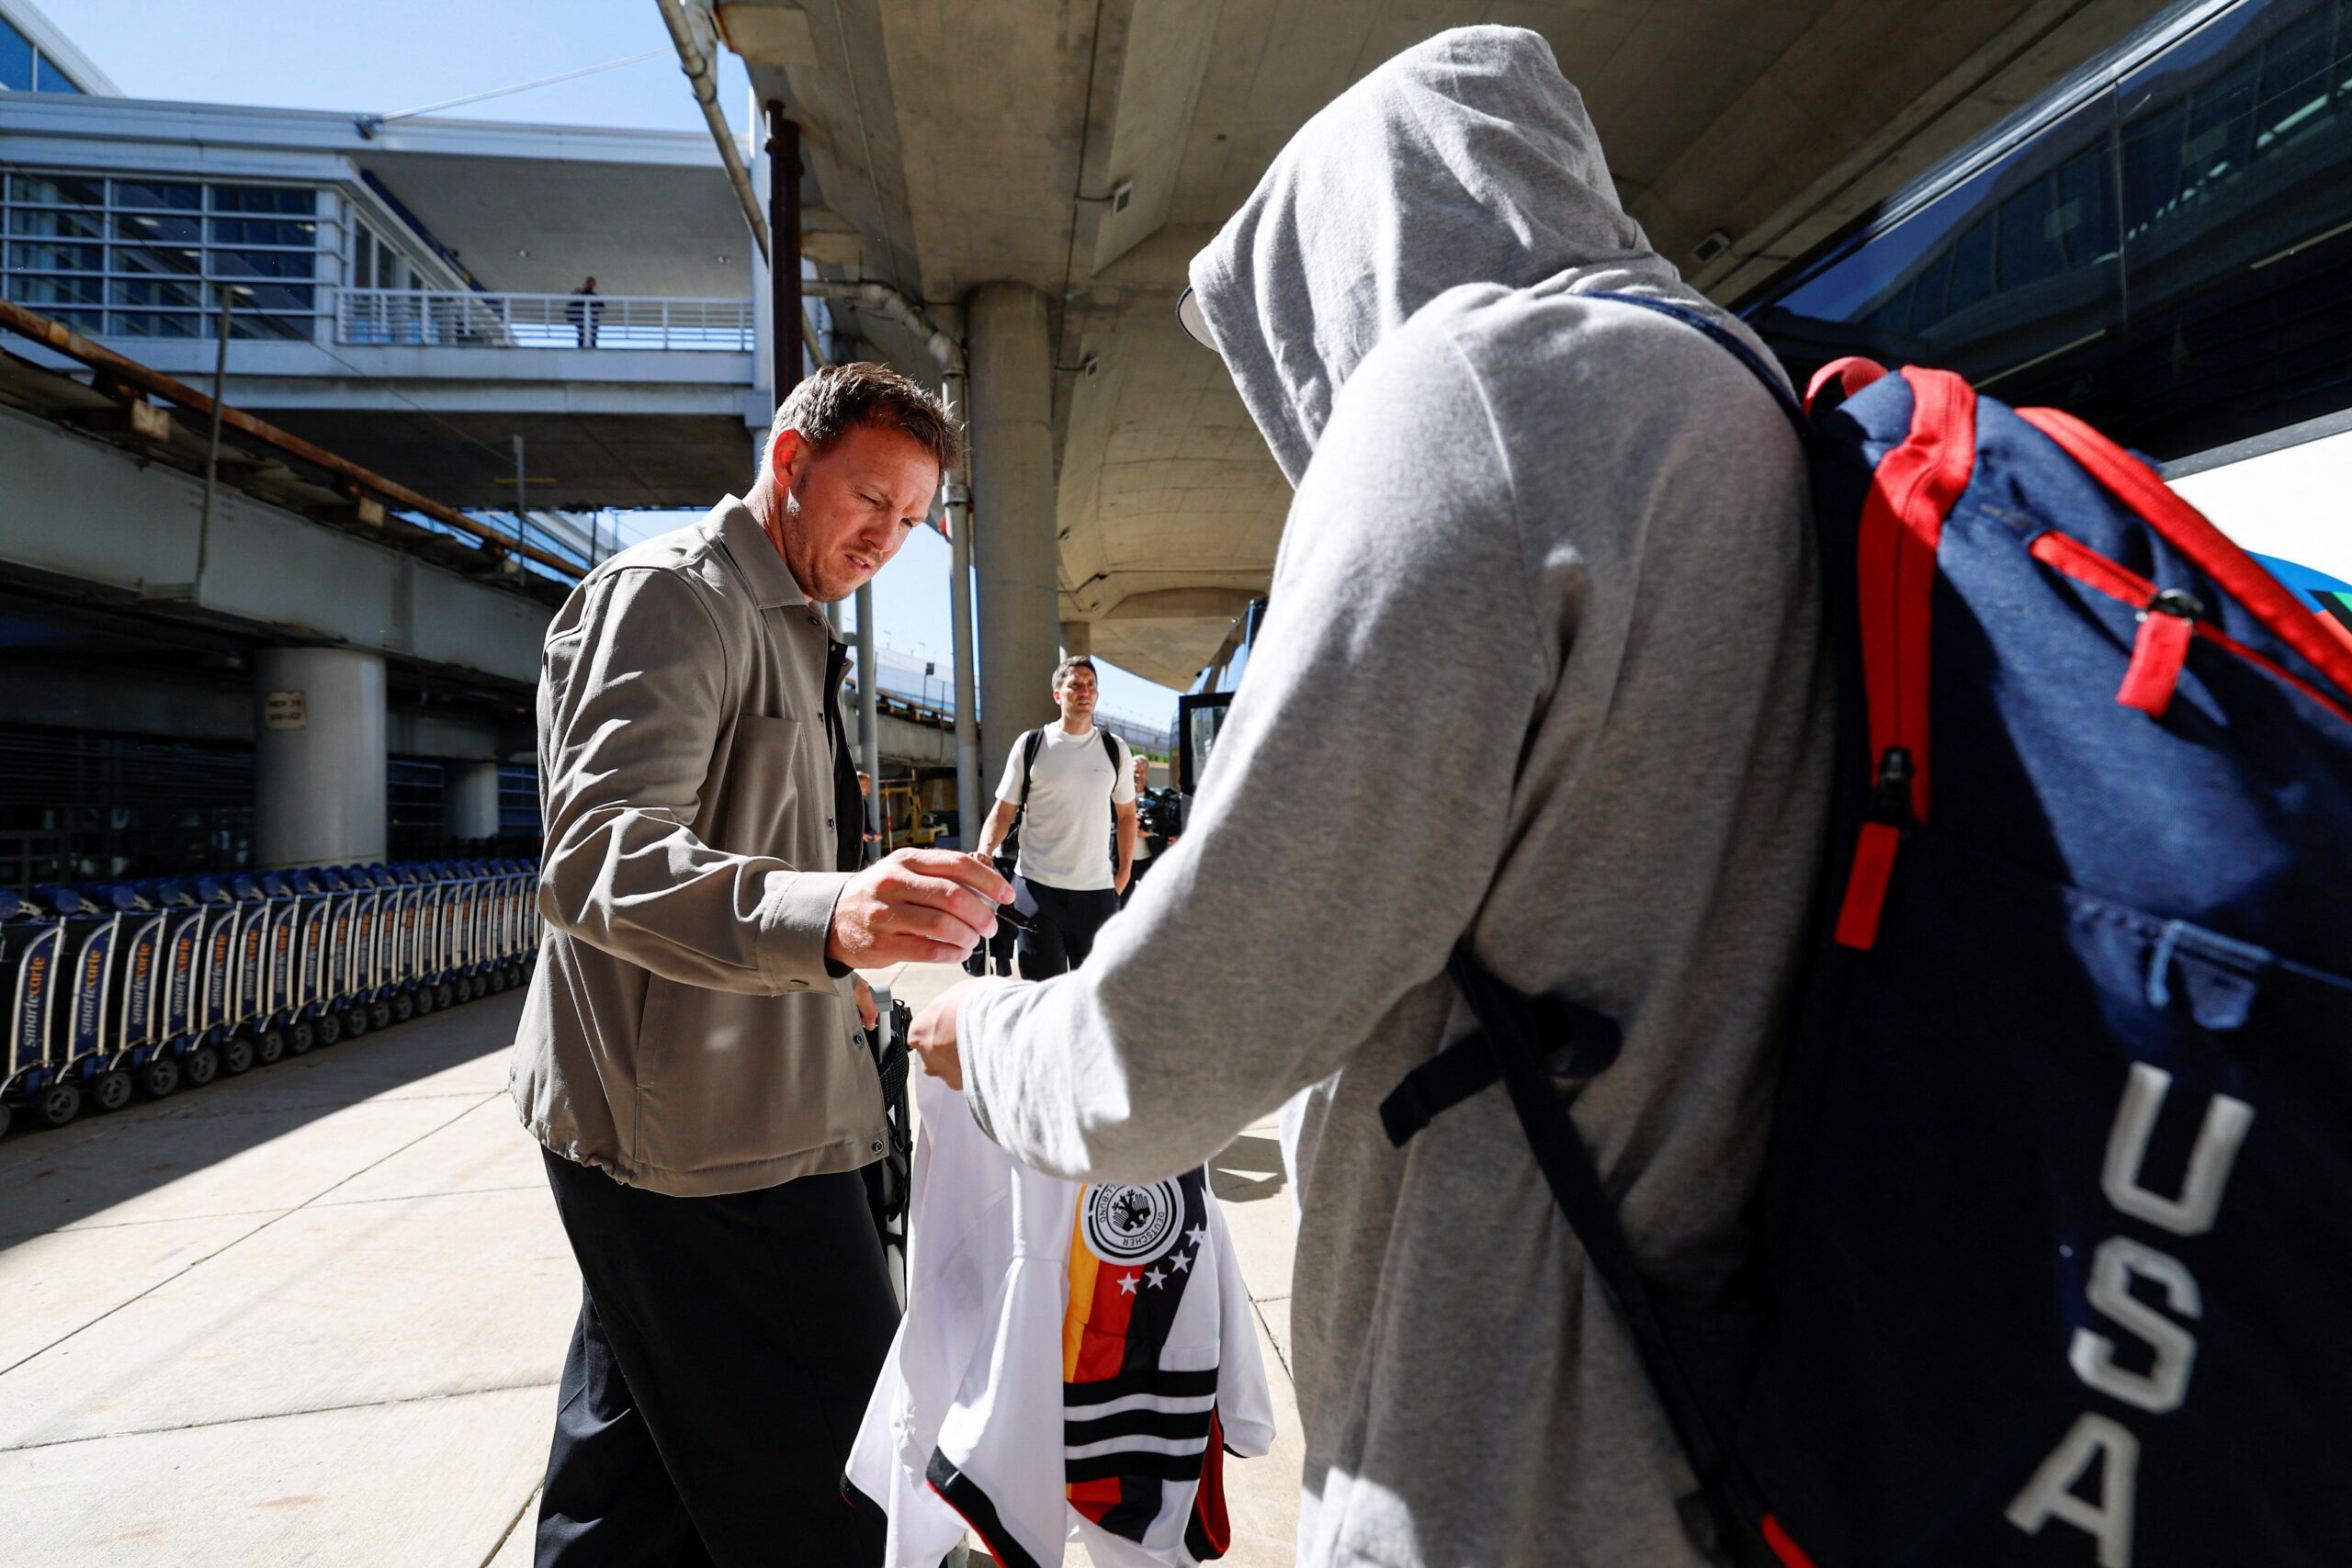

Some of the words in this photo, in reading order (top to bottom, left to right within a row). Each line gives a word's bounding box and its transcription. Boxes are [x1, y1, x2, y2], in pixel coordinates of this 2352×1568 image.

[23, 955, 45, 1047] smartecarte
[80, 950, 102, 1036] smartecarte
[1099, 1183, 1118, 1224] LL-BUND
[1123, 1211, 1165, 1247] DEUTSCHER
[2005, 1060, 2256, 1568] USA
